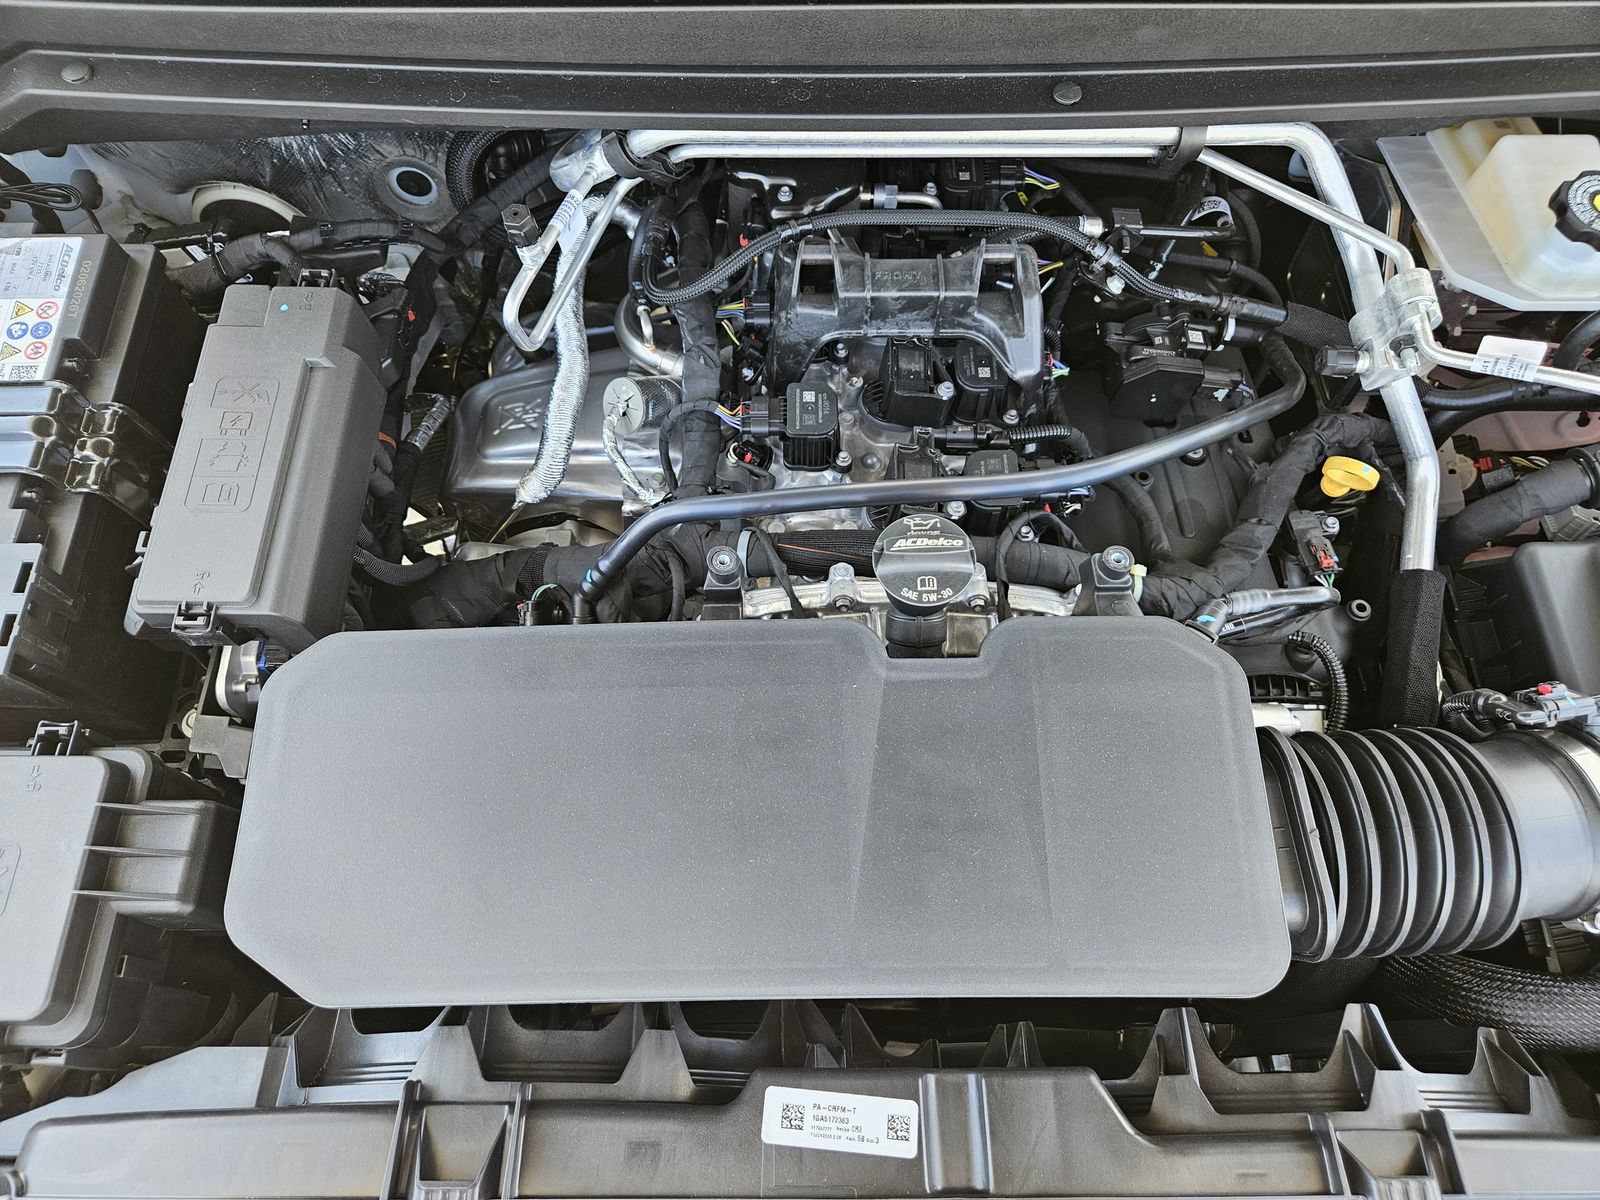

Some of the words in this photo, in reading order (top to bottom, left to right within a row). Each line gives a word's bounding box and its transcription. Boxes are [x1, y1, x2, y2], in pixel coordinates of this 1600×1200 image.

[53, 244, 74, 292] ACDelco
[892, 538, 964, 549] ACDelco
[900, 587, 919, 600] SAE
[922, 587, 953, 602] 5W-30
